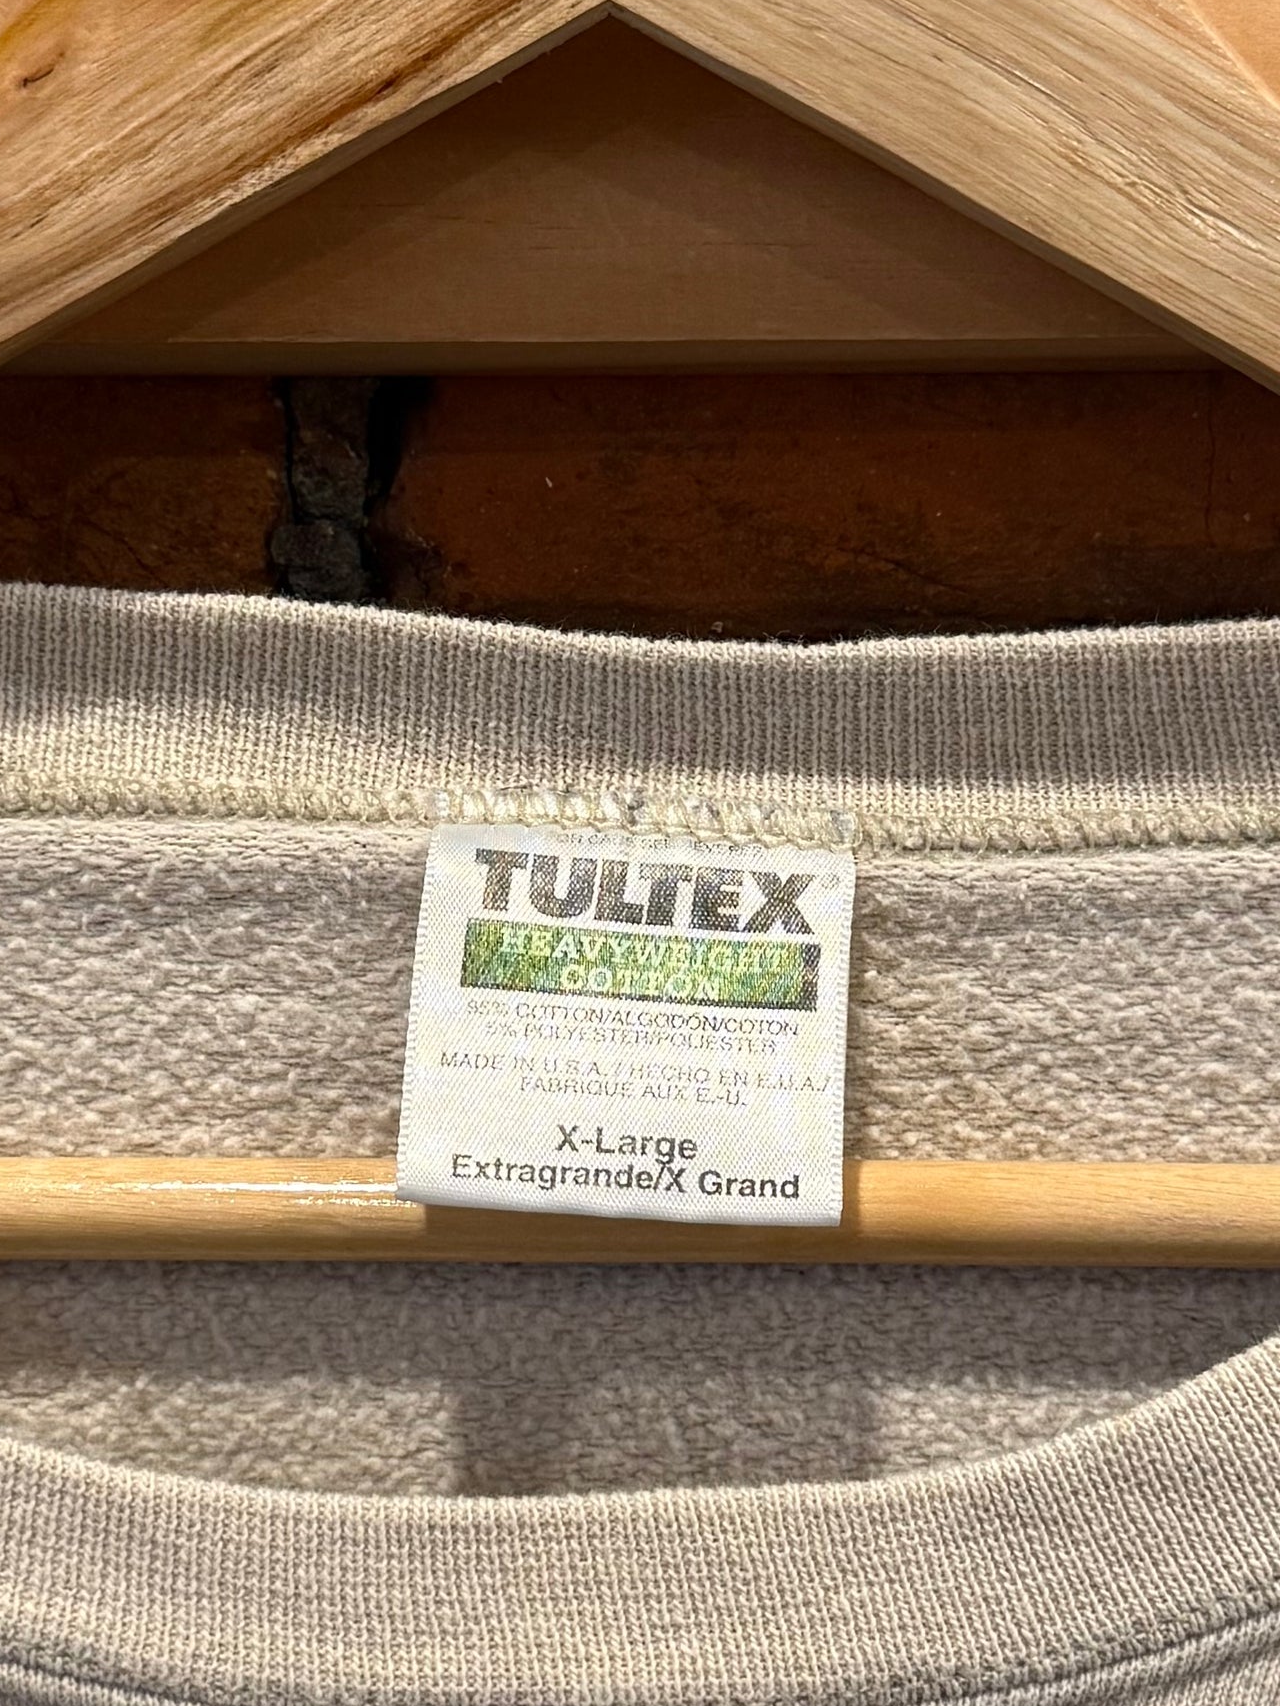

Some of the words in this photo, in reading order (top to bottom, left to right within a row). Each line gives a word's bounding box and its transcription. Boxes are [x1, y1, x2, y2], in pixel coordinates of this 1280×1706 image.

[475, 847, 814, 935] TULTEX
[499, 926, 791, 974] HEAVYWEIGHT
[561, 963, 721, 1001] COTTON
[440, 1051, 505, 1070] MADE
[513, 1056, 536, 1071] IN
[629, 1063, 710, 1084] HECHO
[719, 1068, 749, 1087] EN
[555, 1124, 698, 1164] X-Large
[451, 1153, 688, 1194] Extragrande/X
[697, 1168, 801, 1199] Grand
